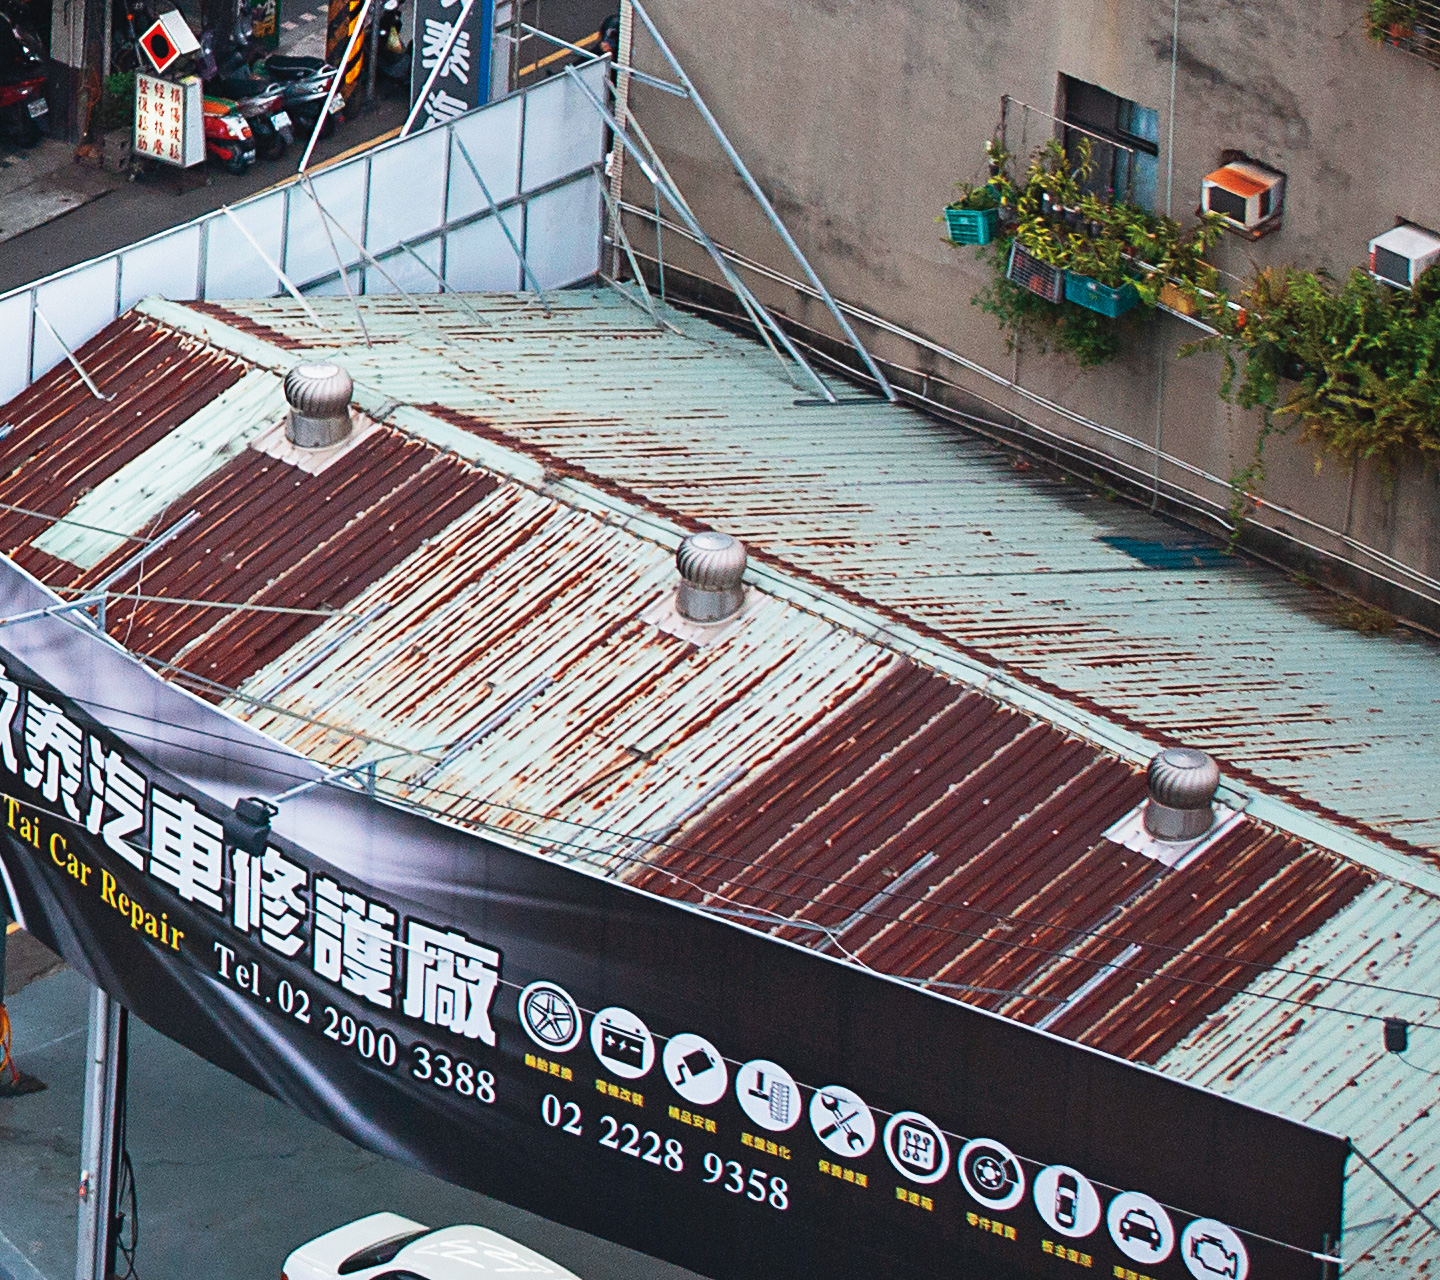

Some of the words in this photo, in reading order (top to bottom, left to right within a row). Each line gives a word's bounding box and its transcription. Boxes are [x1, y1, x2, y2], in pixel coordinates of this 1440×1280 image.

[4, 794, 40, 849] Tai
[49, 833, 92, 886] Car
[100, 868, 185, 951] Repair
[323, 1006, 397, 1067] 2900
[413, 1047, 496, 1104] 3388
[541, 1093, 582, 1136] 02
[598, 1115, 684, 1172] 2228
[702, 1152, 789, 1210] 9358
[668, 1105, 717, 1134] 精品安裝
